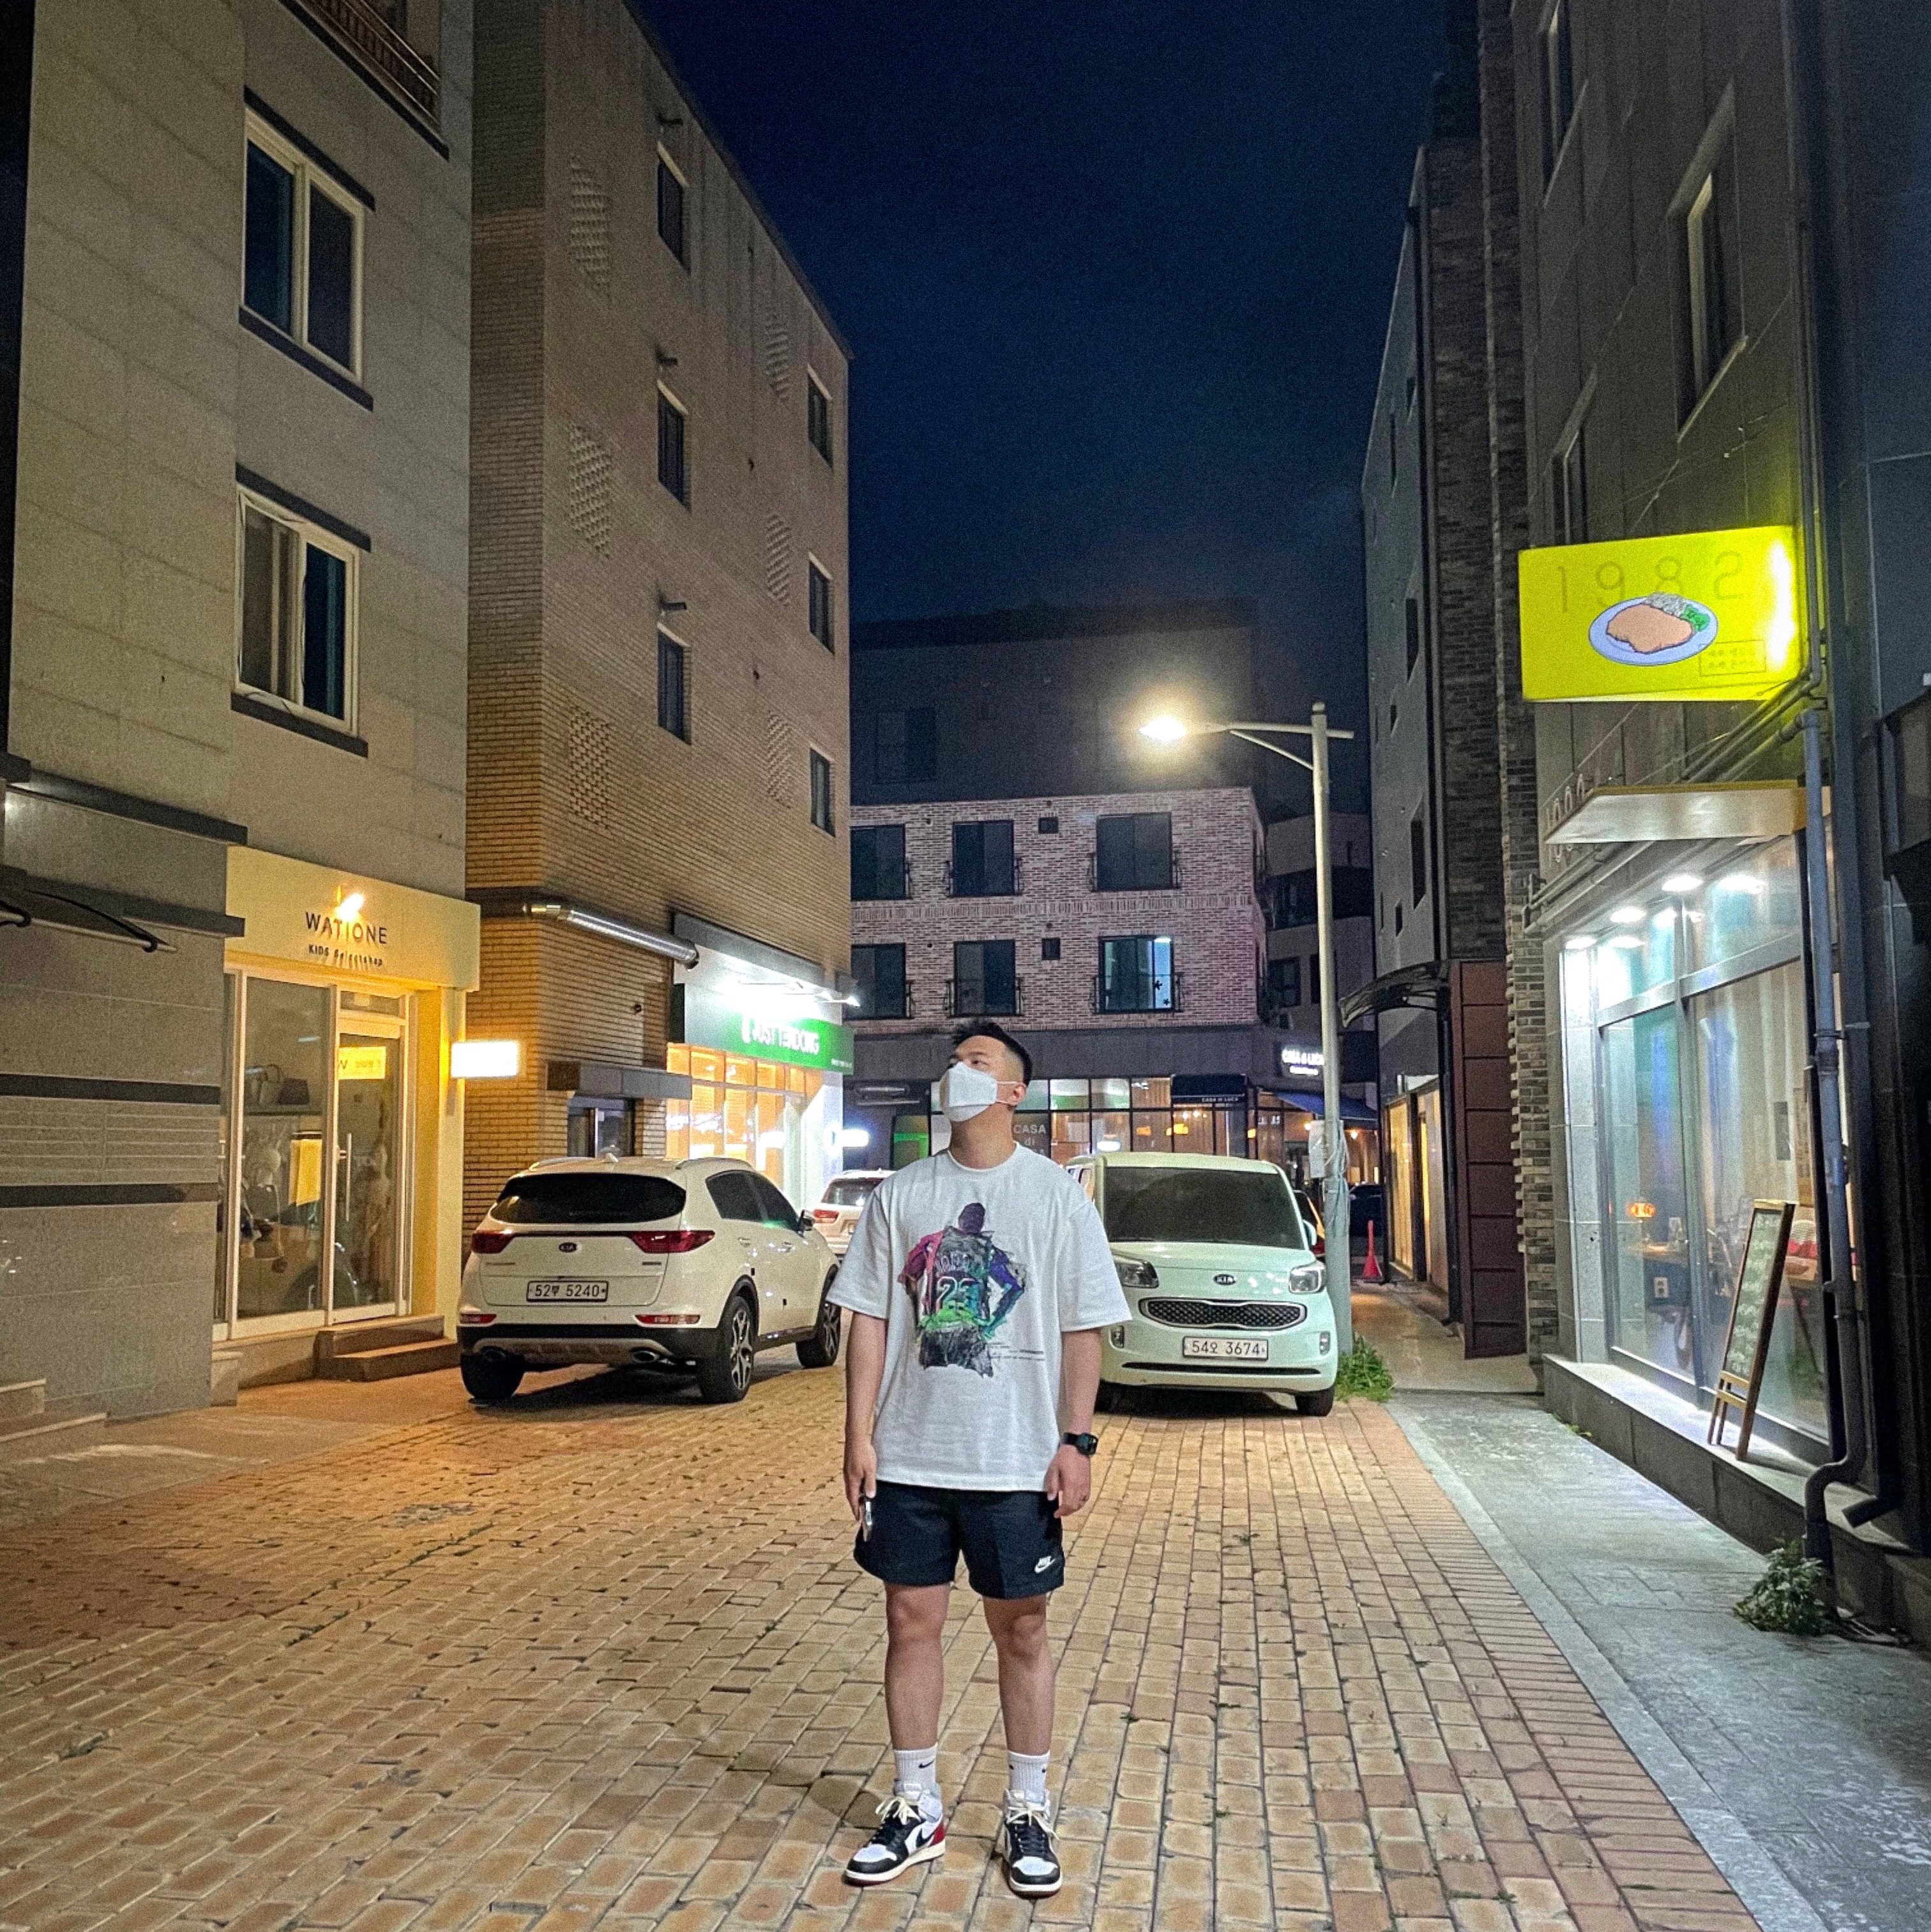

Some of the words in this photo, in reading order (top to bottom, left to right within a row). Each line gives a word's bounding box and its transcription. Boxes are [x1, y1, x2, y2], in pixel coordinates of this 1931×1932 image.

[1558, 551, 1744, 612] 1982
[305, 911, 388, 944] WATIONE
[309, 945, 329, 956] KIDS
[1013, 1124, 1047, 1134] CASA
[566, 1284, 600, 1297] 5240
[1225, 1342, 1259, 1355] 3674
